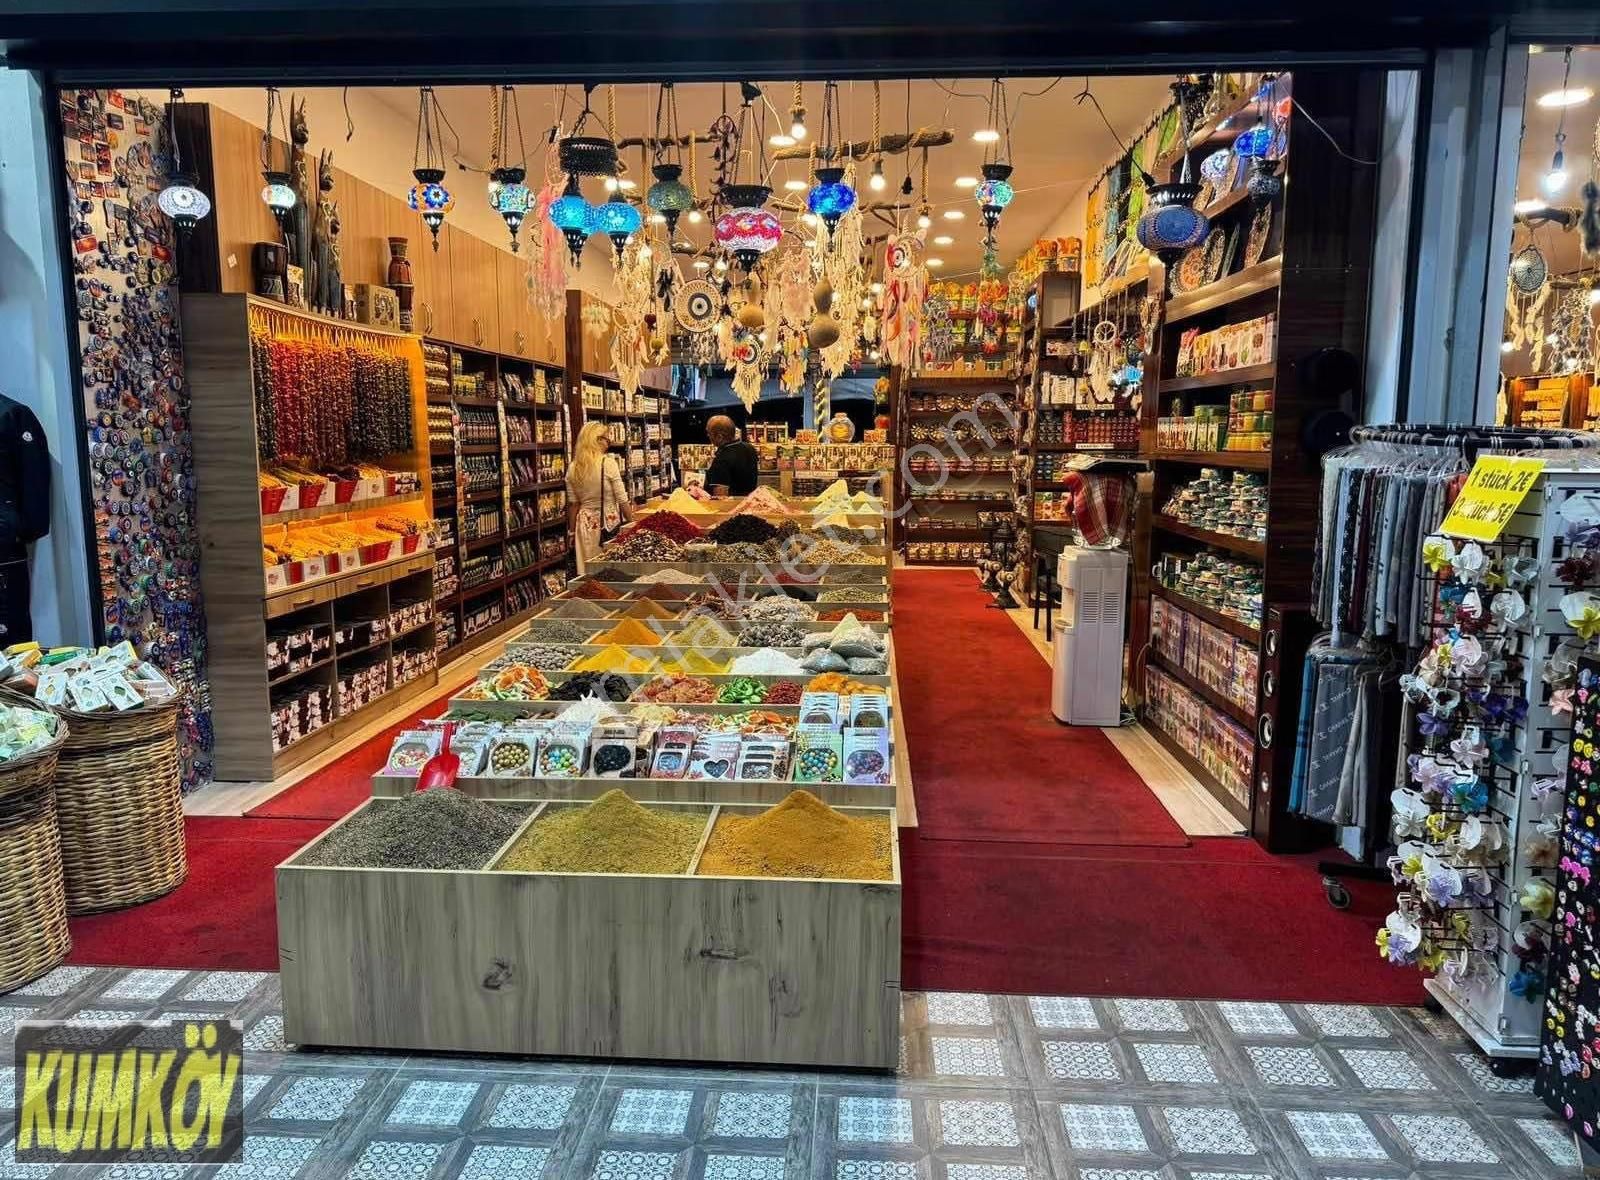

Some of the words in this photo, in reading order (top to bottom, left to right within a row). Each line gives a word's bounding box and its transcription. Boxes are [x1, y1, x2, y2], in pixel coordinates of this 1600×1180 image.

[1472, 467, 1482, 486] 1
[1478, 468, 1513, 490] stück
[1511, 470, 1534, 491] 2€
